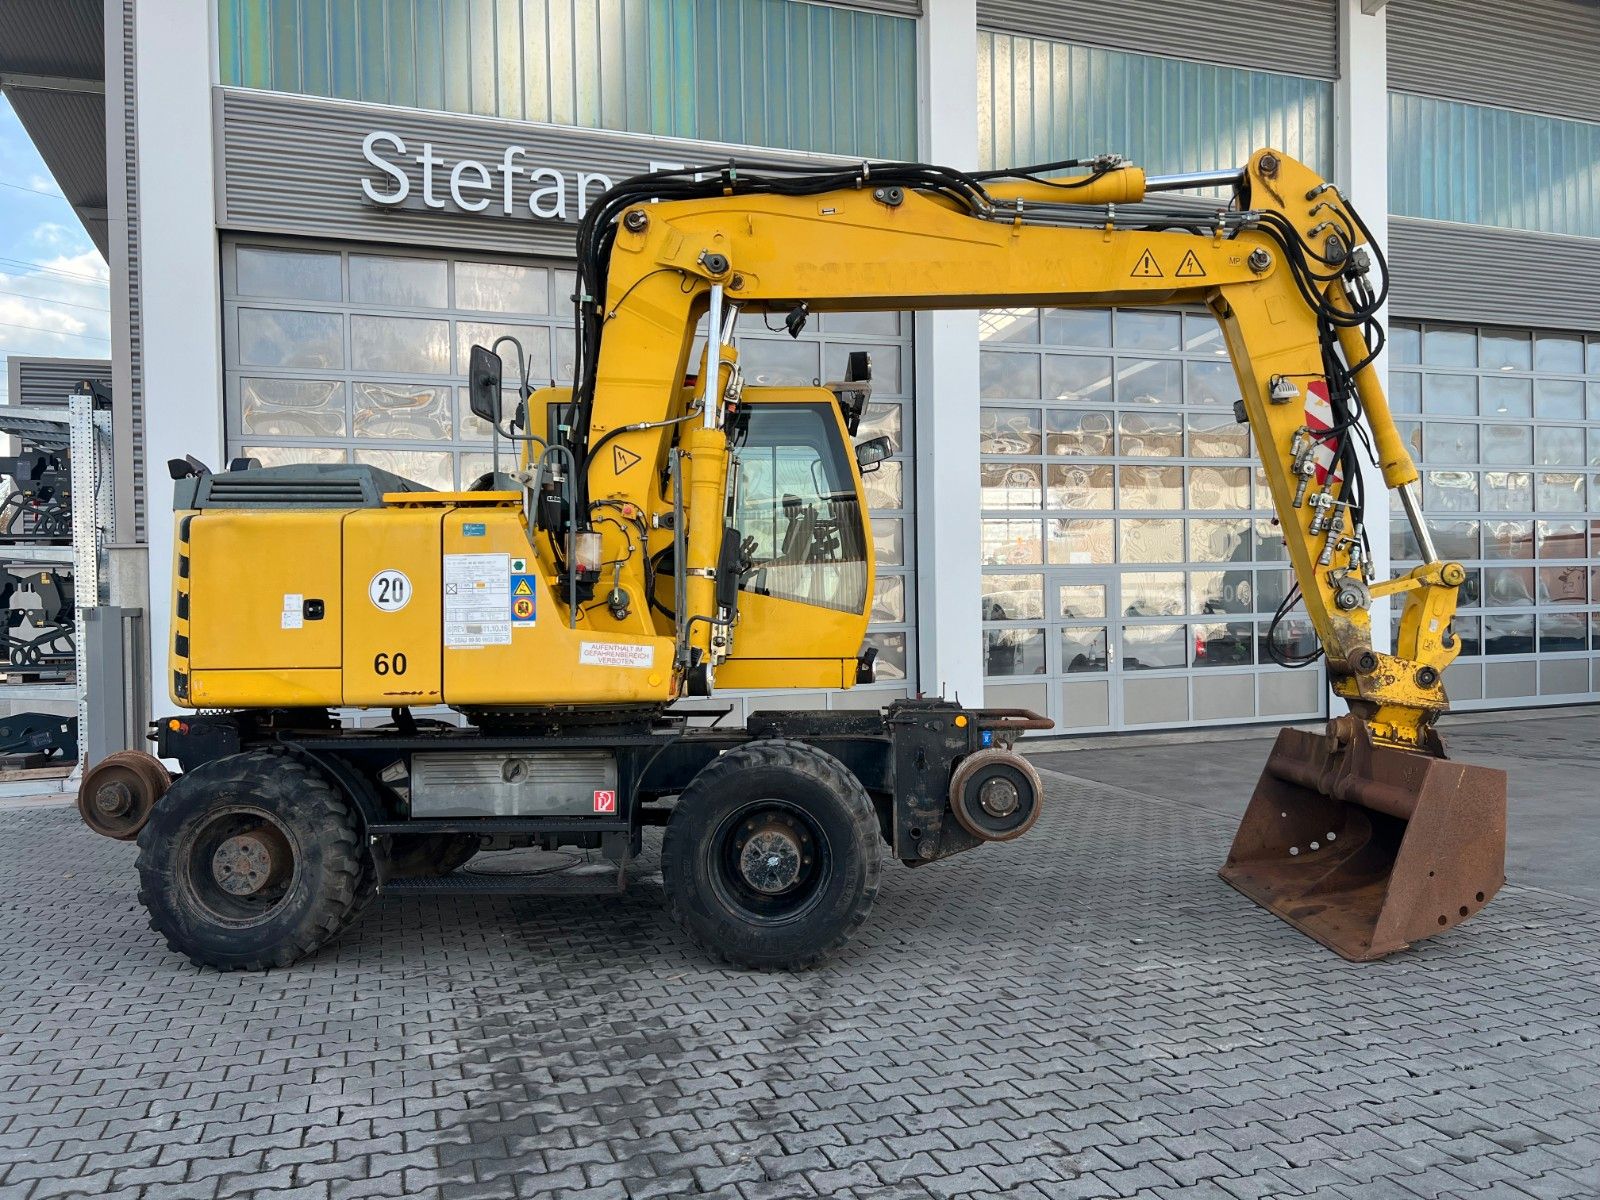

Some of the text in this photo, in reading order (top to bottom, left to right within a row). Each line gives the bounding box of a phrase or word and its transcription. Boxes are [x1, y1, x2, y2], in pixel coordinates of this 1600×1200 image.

[361, 130, 614, 220] Stefan
[378, 577, 404, 603] 20
[584, 649, 649, 659] GEFAHRENBEREICH
[591, 644, 633, 652] AUFENTHALT
[374, 653, 407, 675] 60
[598, 656, 634, 665] VERBOTEN
